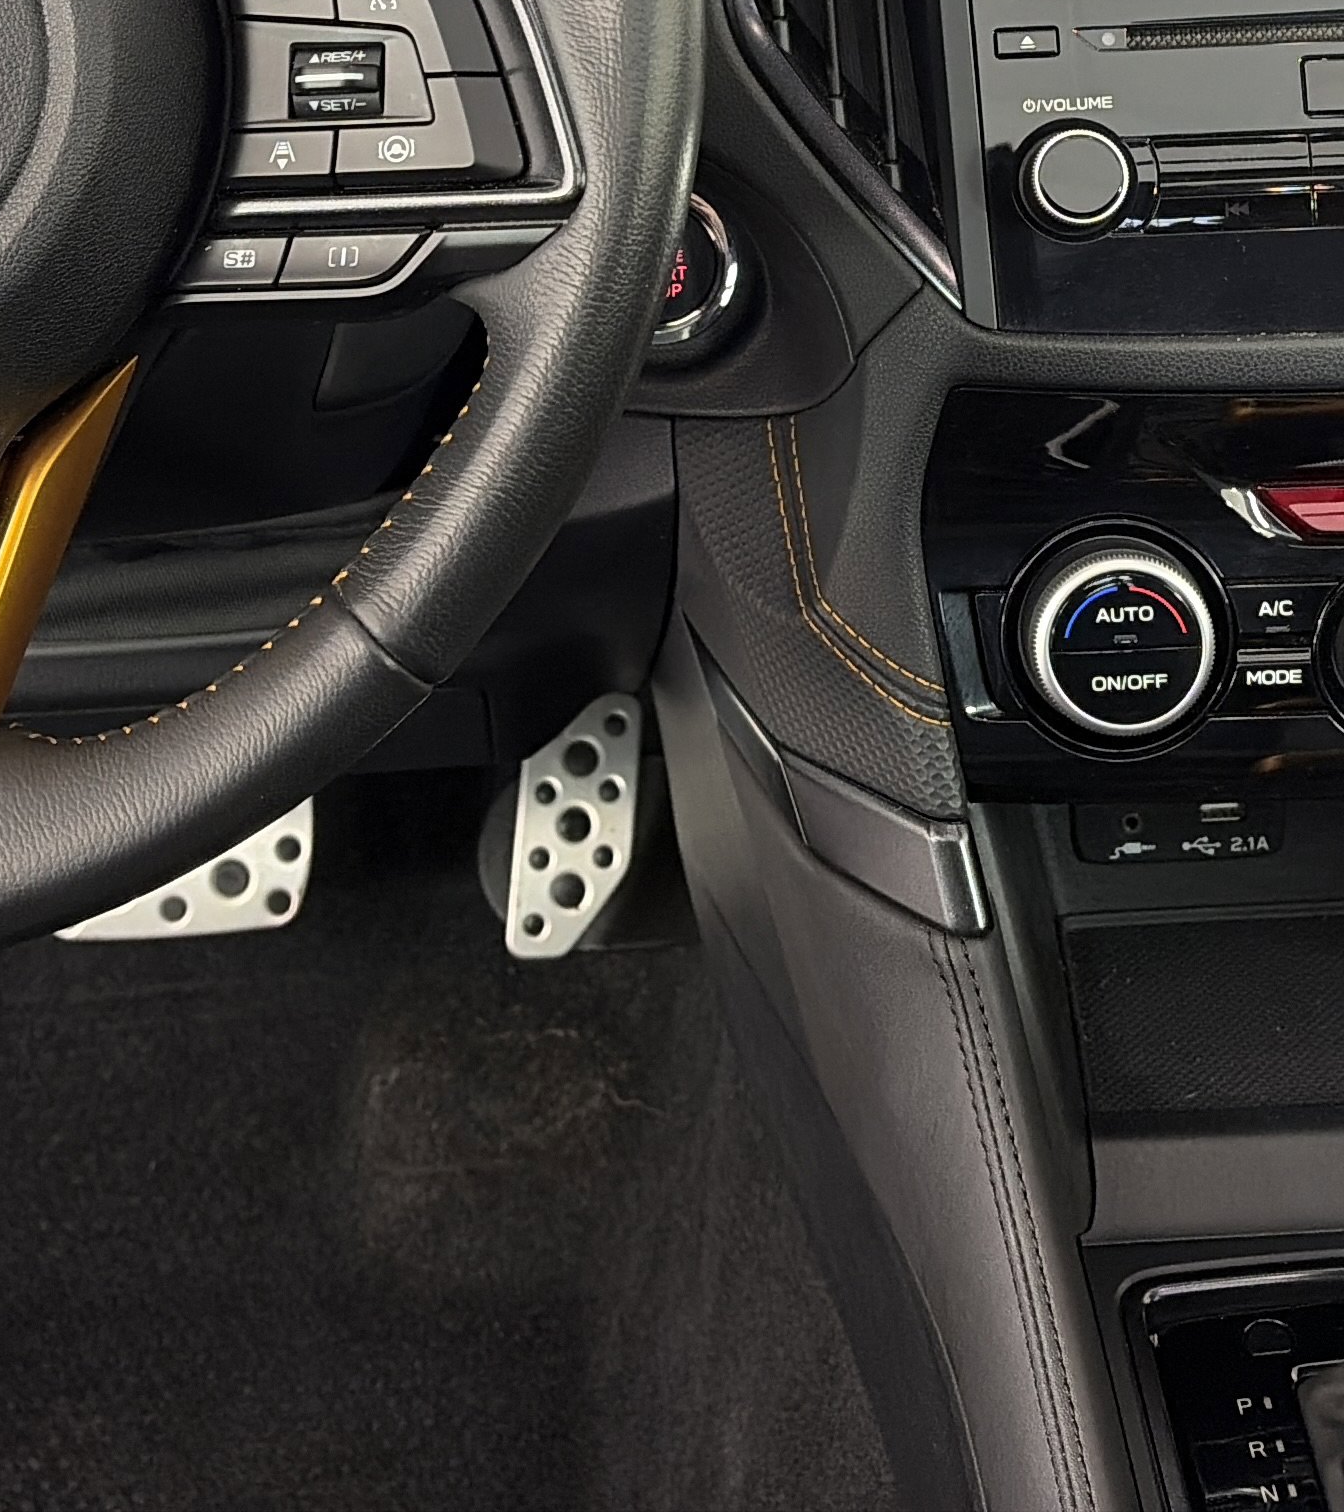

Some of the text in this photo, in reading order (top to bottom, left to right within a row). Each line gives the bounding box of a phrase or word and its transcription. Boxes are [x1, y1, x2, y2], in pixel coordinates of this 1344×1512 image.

[1095, 605, 1154, 624] AUTO
[1258, 599, 1294, 617] A/C
[1091, 673, 1168, 692] ON/OFF
[1246, 668, 1303, 686] MODE
[1230, 836, 1269, 852] 2.1A
[1237, 1398, 1252, 1415] P
[1249, 1441, 1267, 1458] R
[1260, 1485, 1279, 1502] N
